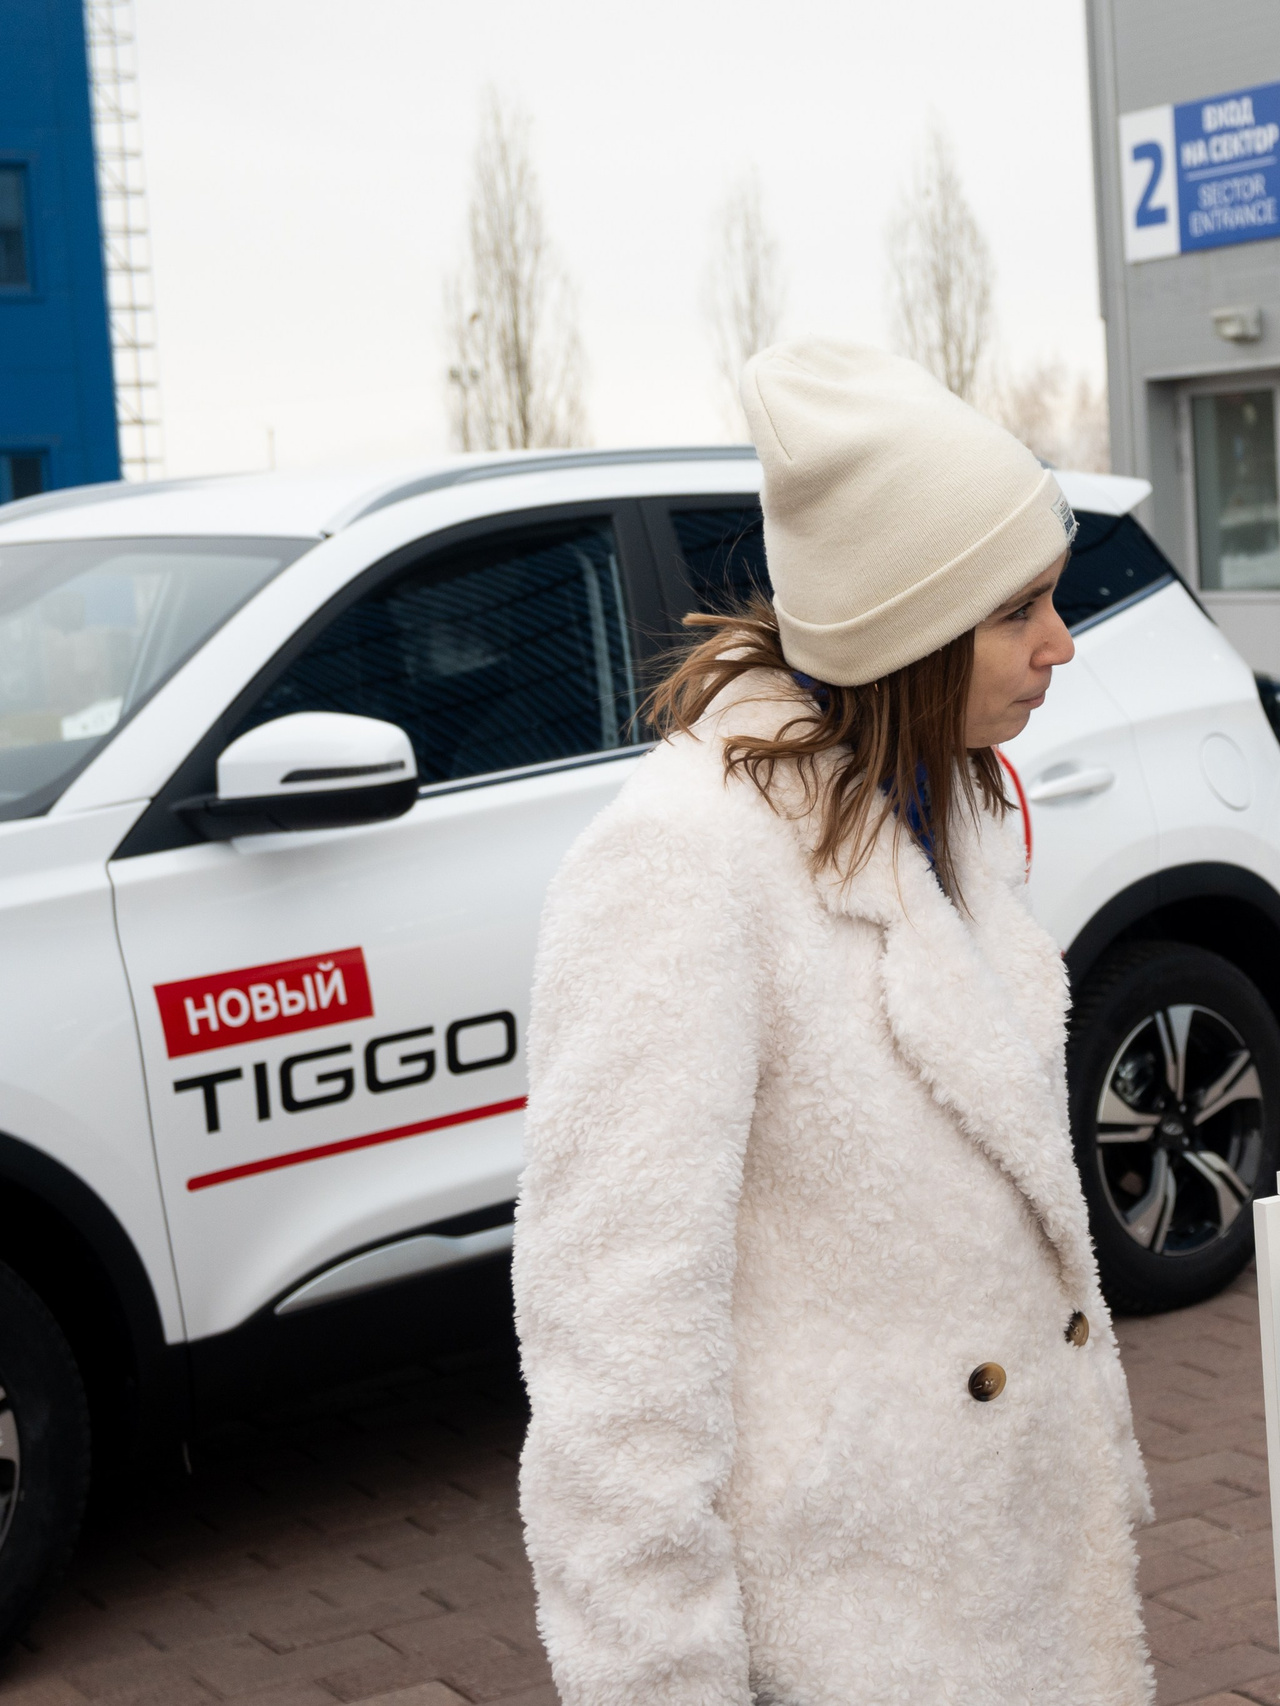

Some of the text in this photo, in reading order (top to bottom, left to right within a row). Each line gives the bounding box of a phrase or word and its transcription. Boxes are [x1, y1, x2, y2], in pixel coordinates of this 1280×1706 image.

[1202, 96, 1255, 133] ВХОД
[1181, 123, 1280, 169] НА СЕКТОР
[1131, 138, 1169, 230] 2
[1198, 173, 1267, 210] SECTOR
[1188, 197, 1278, 238] ENTRANCE
[183, 960, 348, 1036] НОВЫЙ
[173, 1010, 517, 1134] TIGGO
